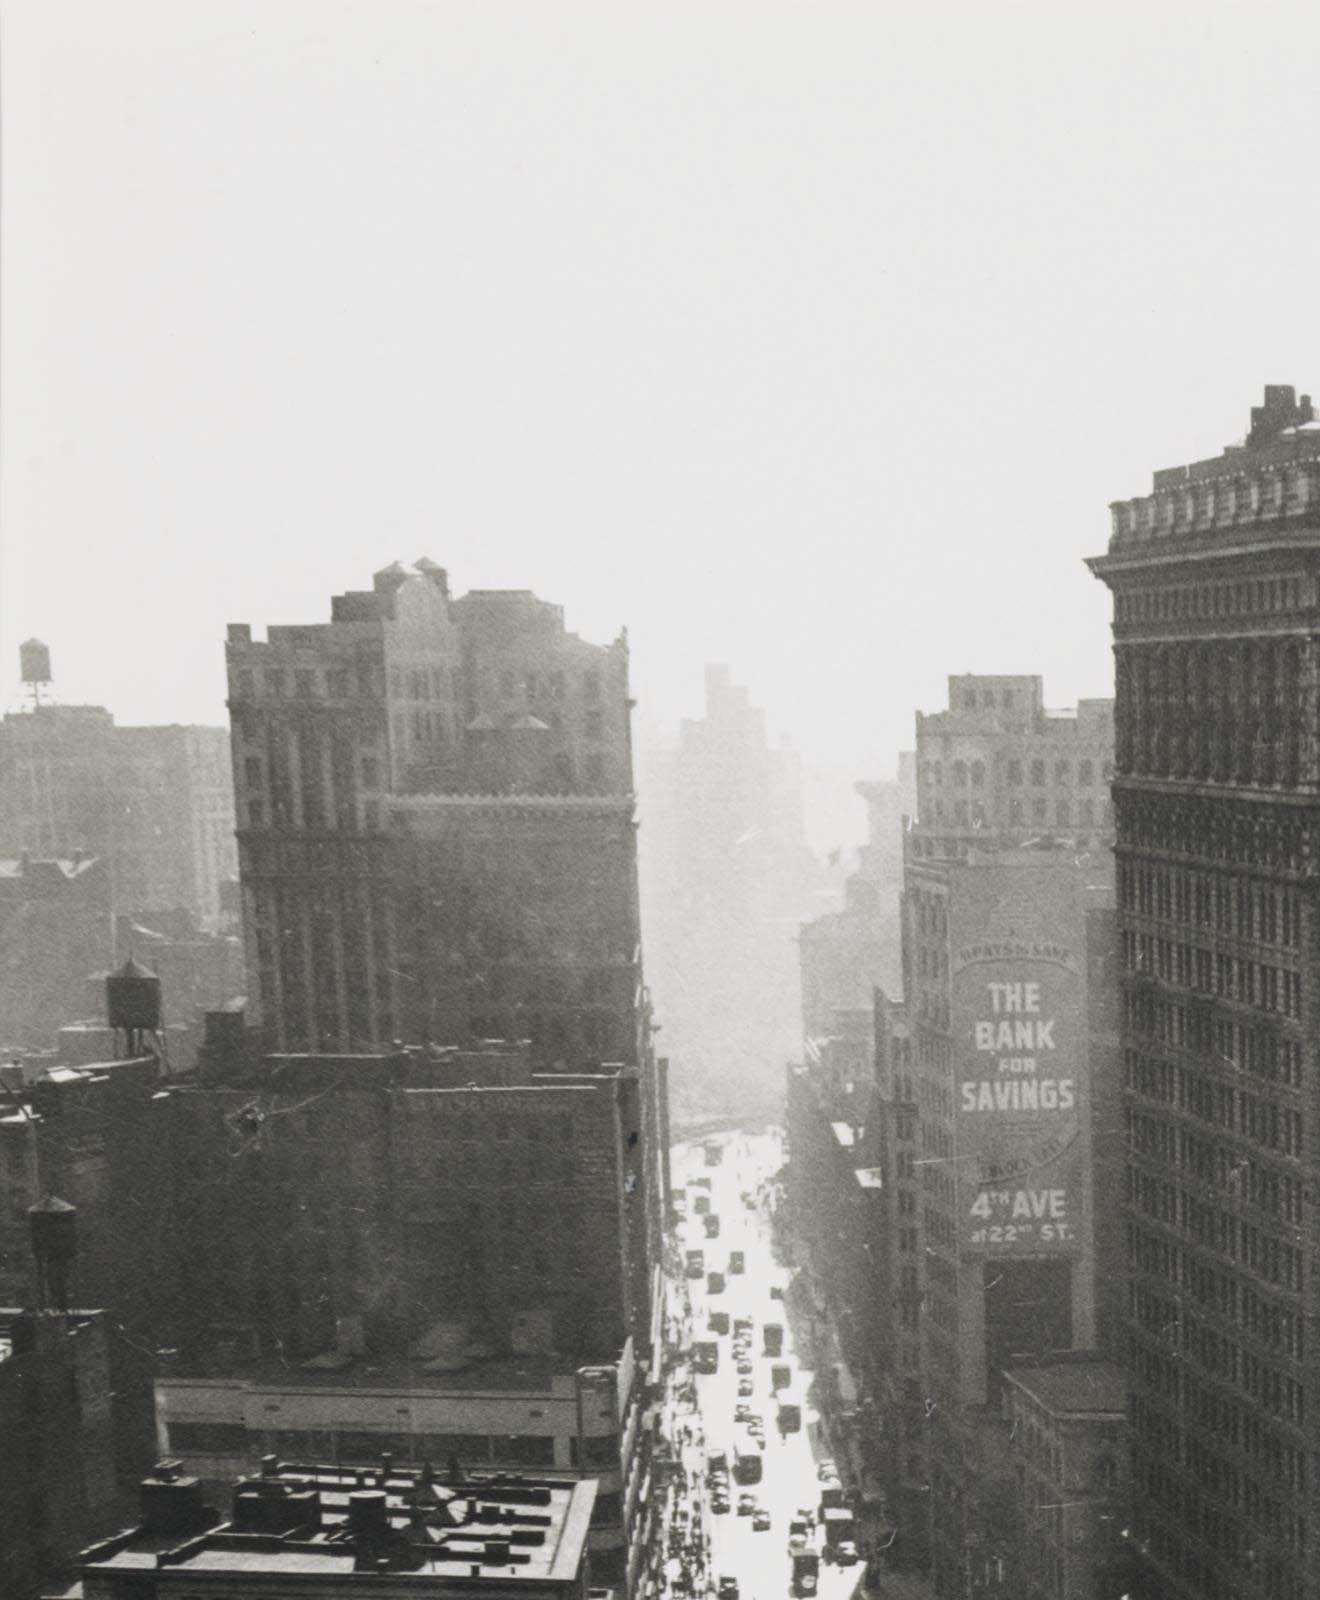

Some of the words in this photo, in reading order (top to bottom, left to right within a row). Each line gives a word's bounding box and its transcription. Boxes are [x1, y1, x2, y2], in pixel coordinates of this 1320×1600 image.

[987, 981, 1041, 1013] THE
[974, 1019, 1056, 1051] BANK
[999, 1057, 1036, 1073] FOR
[960, 1078, 1075, 1112] SAVINGS
[1012, 1189, 1067, 1219] AVE
[1040, 1223, 1075, 1242] ST.
